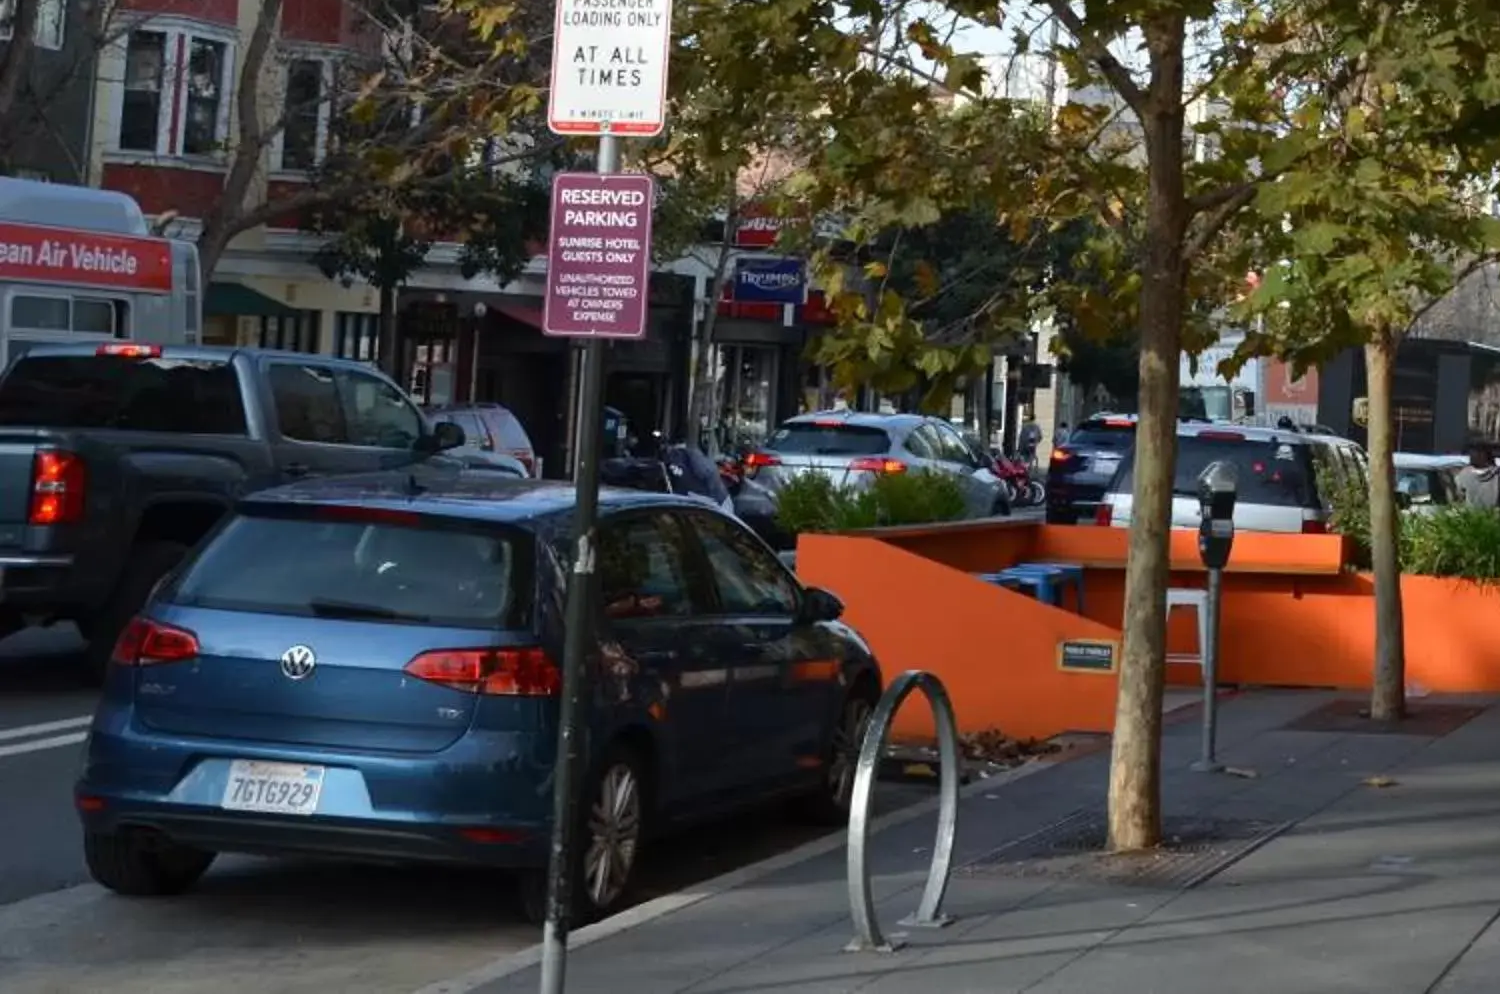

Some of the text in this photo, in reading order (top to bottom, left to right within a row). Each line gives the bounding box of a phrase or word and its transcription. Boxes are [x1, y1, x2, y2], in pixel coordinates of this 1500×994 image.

[563, 11, 662, 26] LOADING ONLY
[573, 45, 648, 64] AT ALL
[578, 68, 641, 86] TIMES
[560, 189, 645, 206] RESERVED
[564, 210, 638, 227] PARKING
[559, 237, 640, 250] SUNRISE HOTEL
[36, 239, 68, 269] Air
[70, 242, 138, 275] Vehicle
[561, 251, 636, 263] GUESTS ONLY
[555, 285, 637, 298] VEHICLES TOWED
[567, 298, 580, 309] AT
[231, 777, 313, 807] 7GTG929
